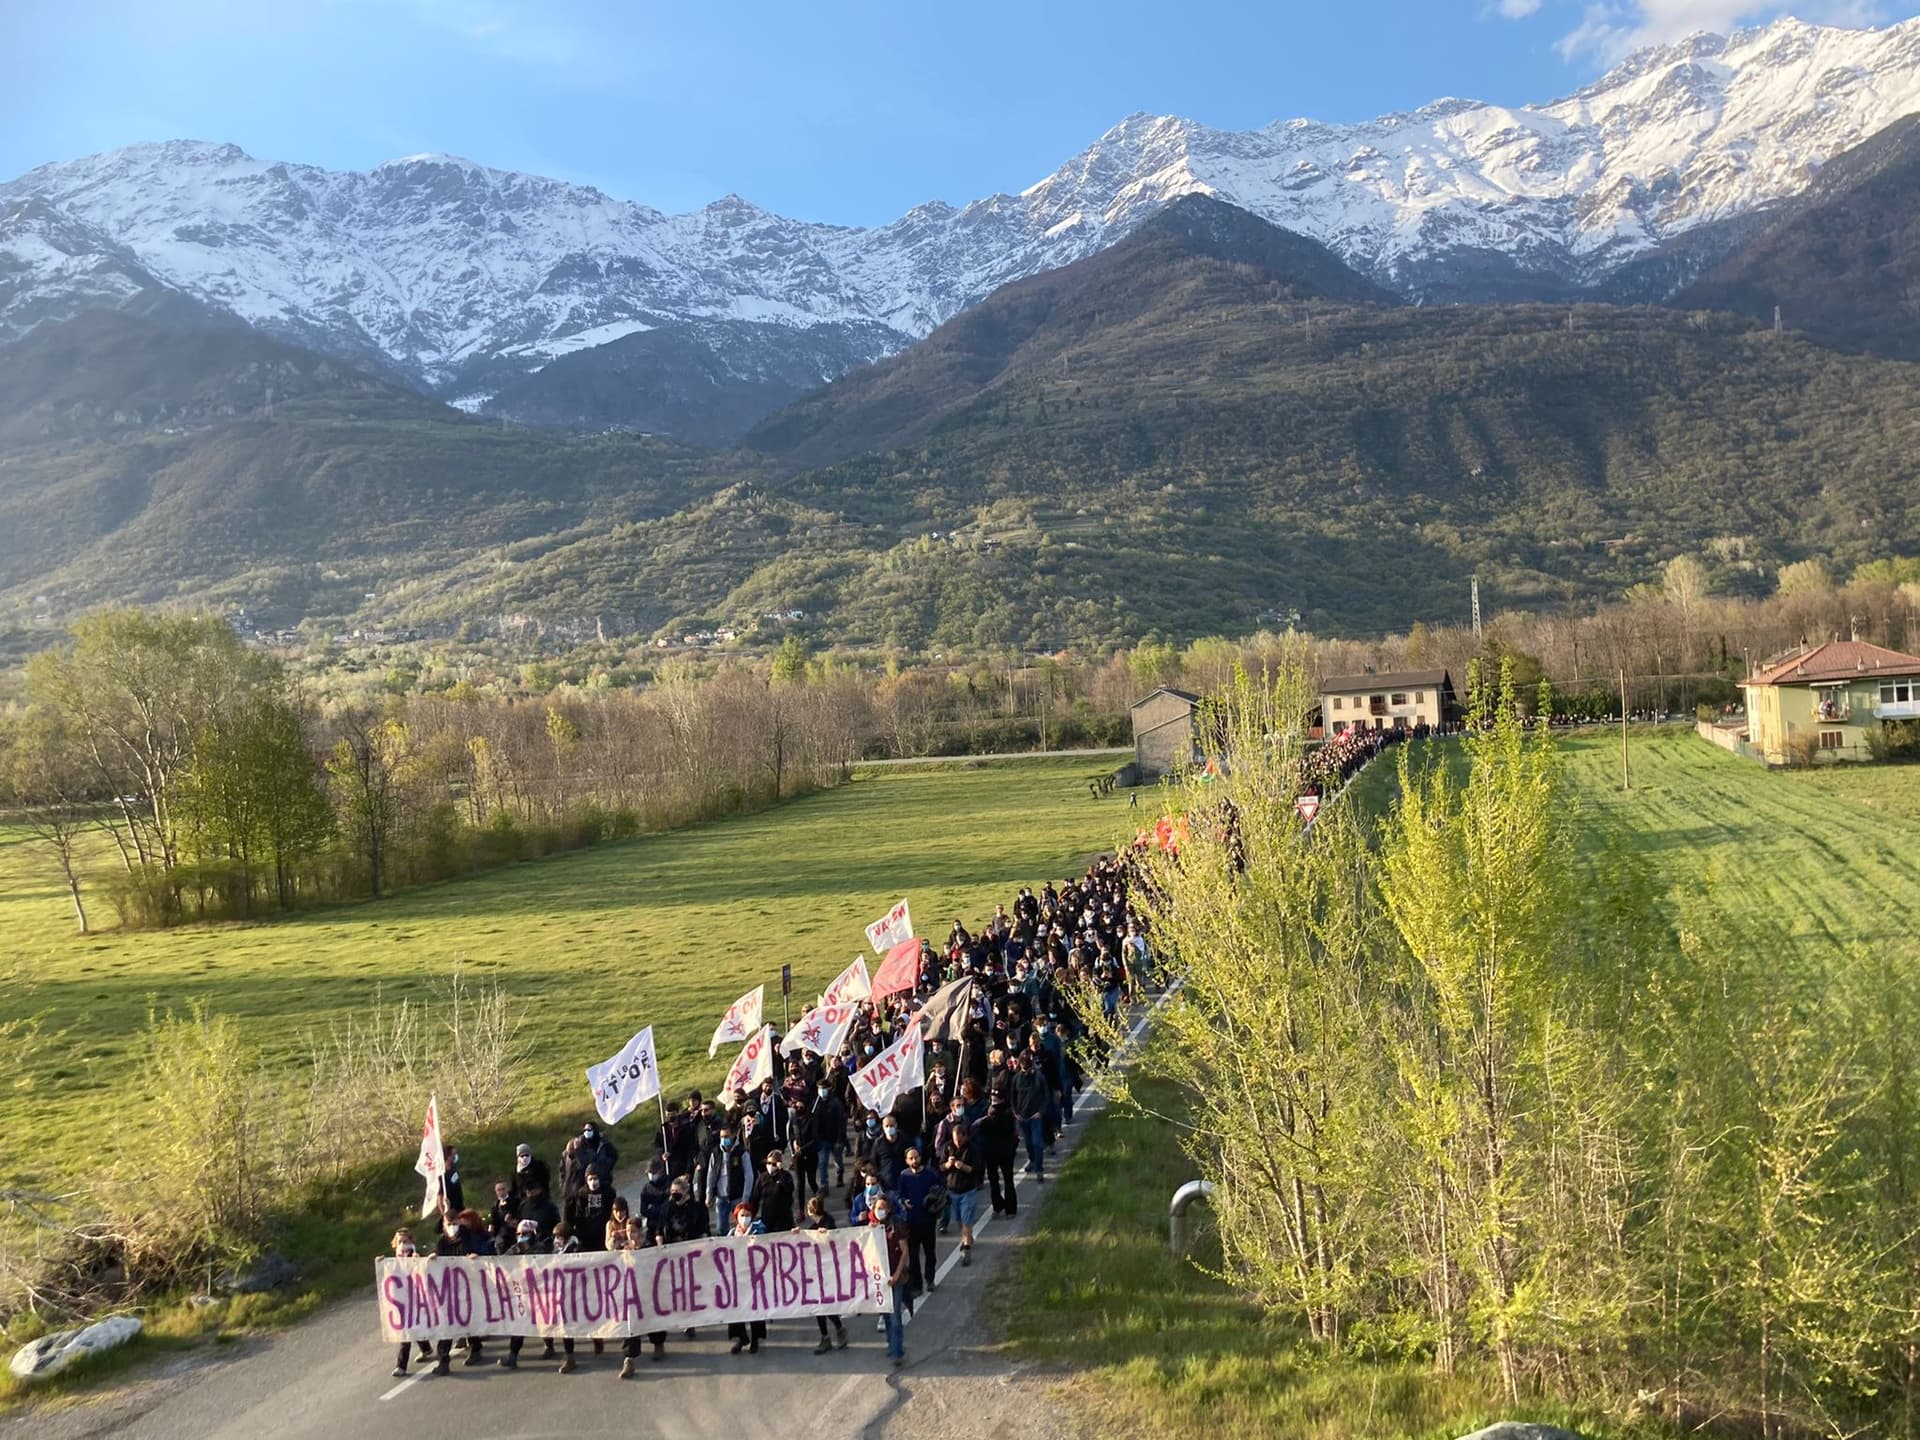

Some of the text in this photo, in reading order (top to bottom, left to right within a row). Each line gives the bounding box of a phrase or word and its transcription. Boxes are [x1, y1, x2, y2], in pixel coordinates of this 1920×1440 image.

[384, 1239, 870, 1330] SIAMO LA NATURA CHE SI RIBELLA
[872, 1265, 884, 1307] NO TAV
